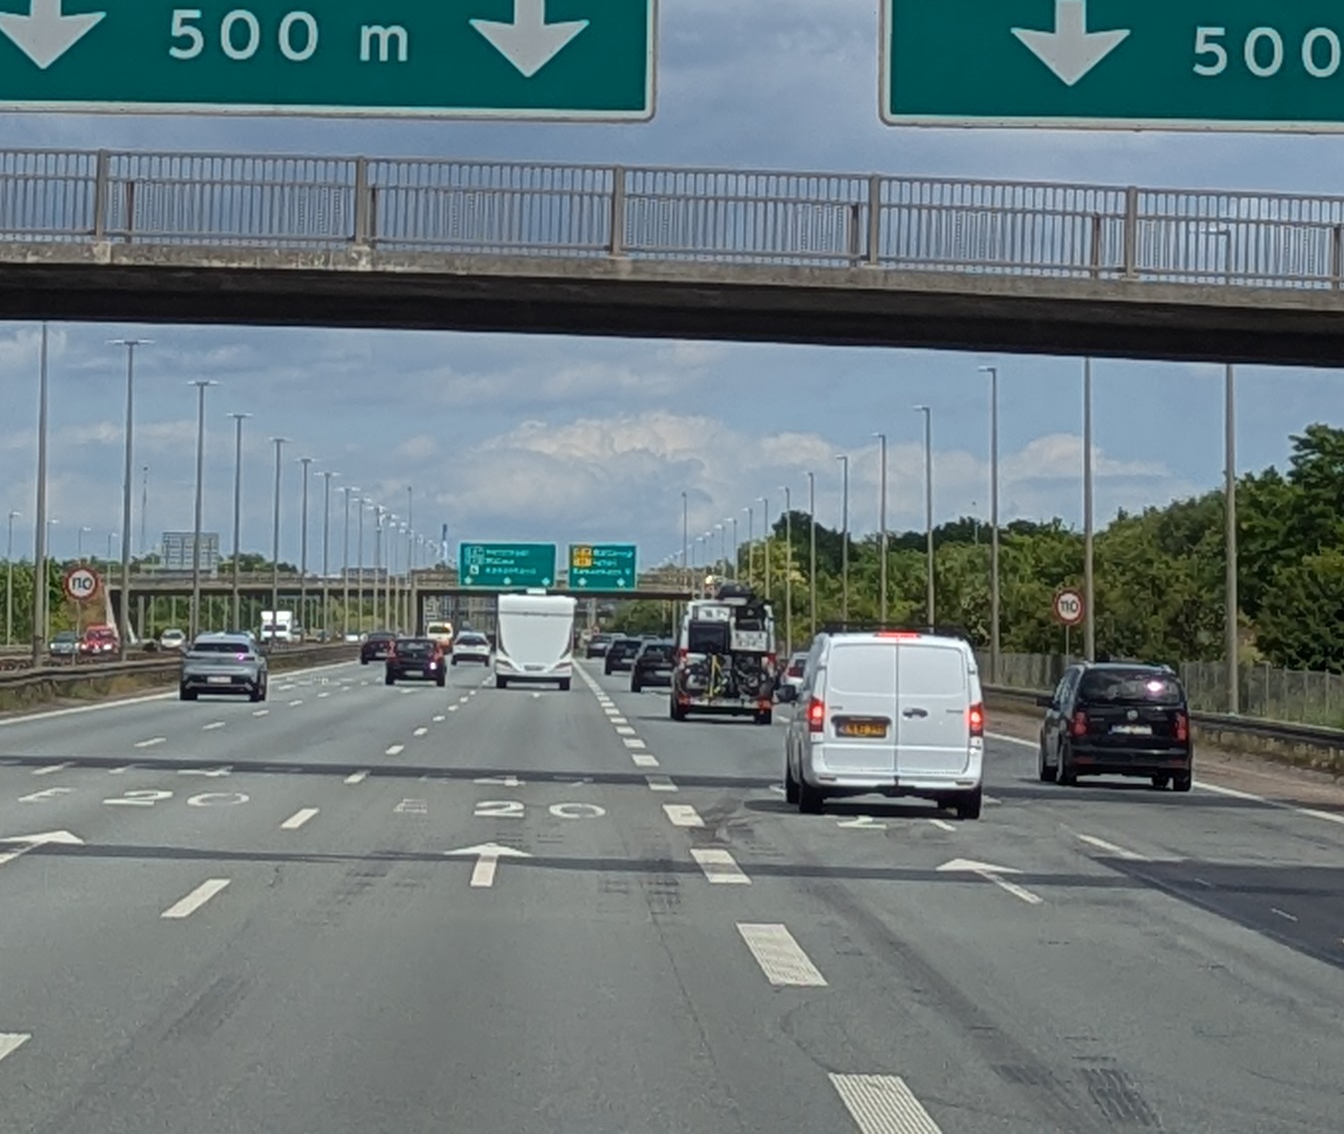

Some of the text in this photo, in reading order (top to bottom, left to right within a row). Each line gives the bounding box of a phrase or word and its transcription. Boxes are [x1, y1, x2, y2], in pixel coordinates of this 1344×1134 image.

[169, 9, 408, 61] 500 m
[1193, 27, 1341, 77] 500
[72, 577, 93, 591] 110
[1060, 600, 1078, 613] 110
